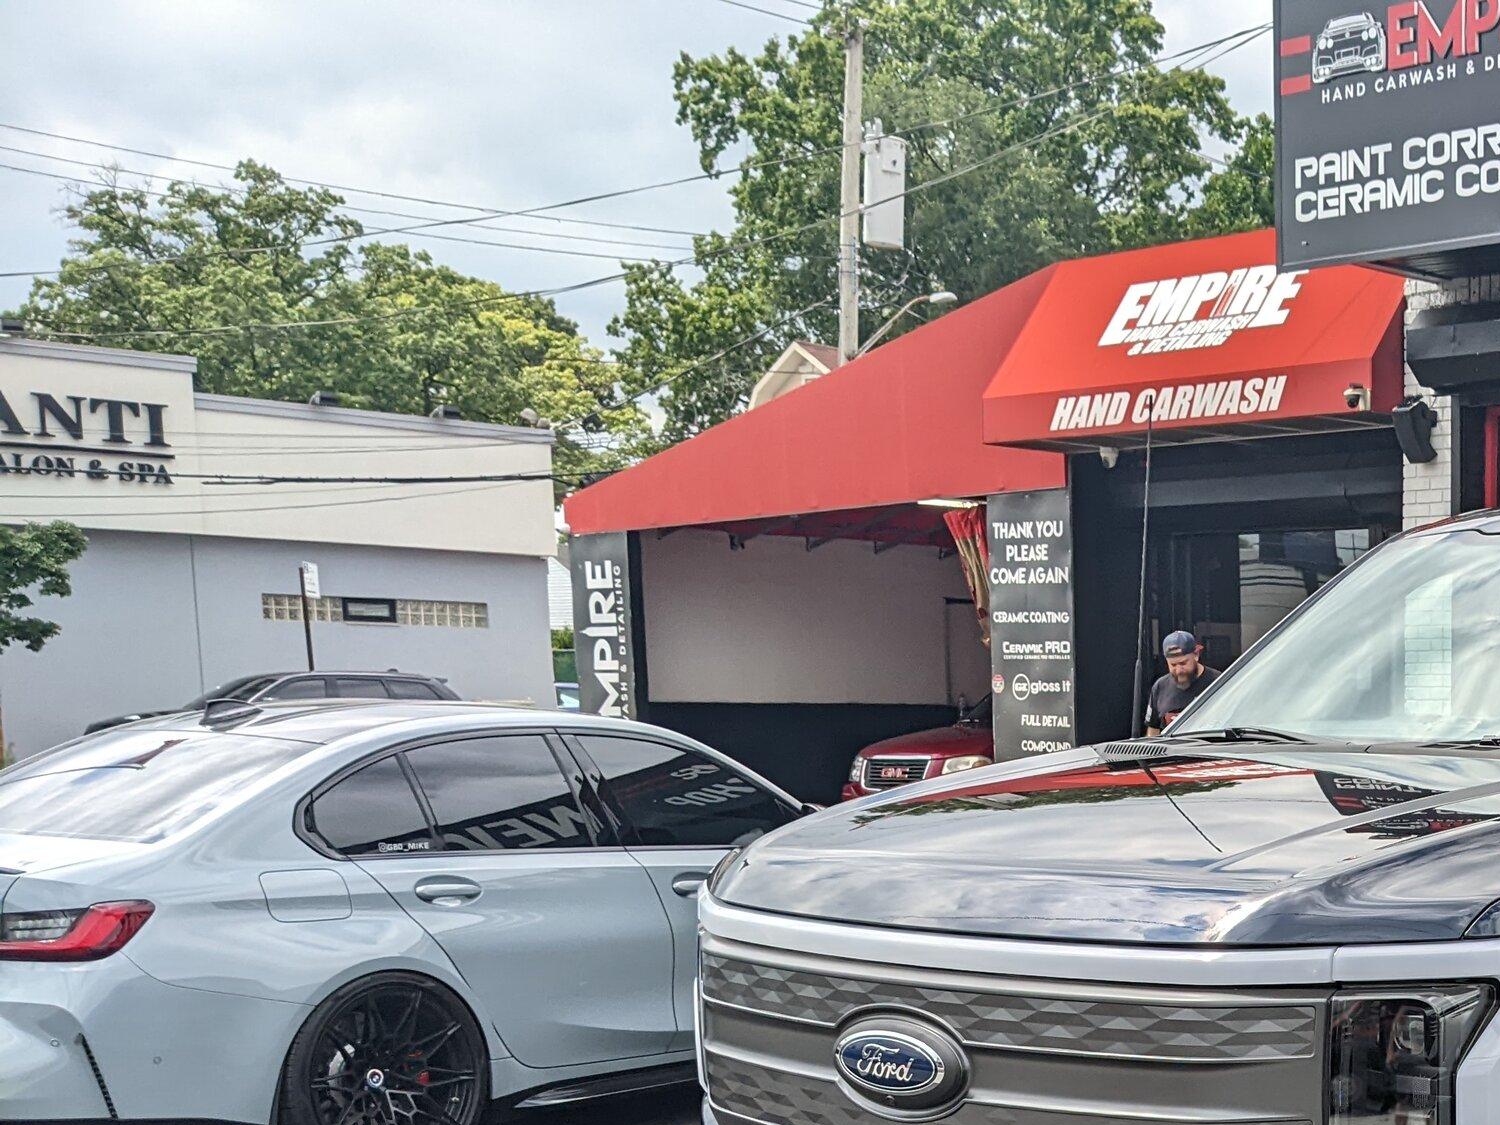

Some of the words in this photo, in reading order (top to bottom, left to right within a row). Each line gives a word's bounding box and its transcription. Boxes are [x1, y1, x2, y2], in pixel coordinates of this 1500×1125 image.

[1321, 82, 1366, 104] HAND
[1374, 64, 1457, 94] CARWASH
[1466, 62, 1475, 76] &
[1295, 143, 1392, 189] PAINT
[1295, 169, 1445, 223] CERAMIC
[1098, 264, 1310, 346] EMPIRE
[1141, 328, 1233, 355] DETAILING
[1050, 391, 1130, 431] HAND
[1131, 375, 1287, 423] CARWASH
[86, 458, 109, 480] &
[118, 461, 175, 484] SPA
[992, 521, 1034, 539] THANK
[1035, 520, 1064, 538] YOU
[1005, 543, 1049, 562] PLEASE
[990, 567, 1027, 585] COME
[1027, 566, 1069, 584] AGAIN
[612, 565, 627, 656] DETAILING
[992, 611, 1029, 623] CERAMIC
[1029, 611, 1070, 624] COATING
[1045, 641, 1071, 653] PRO
[1030, 680, 1060, 695] gloss
[1062, 680, 1071, 693] it
[1021, 715, 1041, 727] FULL
[1042, 715, 1071, 728] DETAIL
[1021, 740, 1072, 753] COMPOUND
[880, 767, 910, 778] GMC
[857, 1043, 914, 1082] Ford
